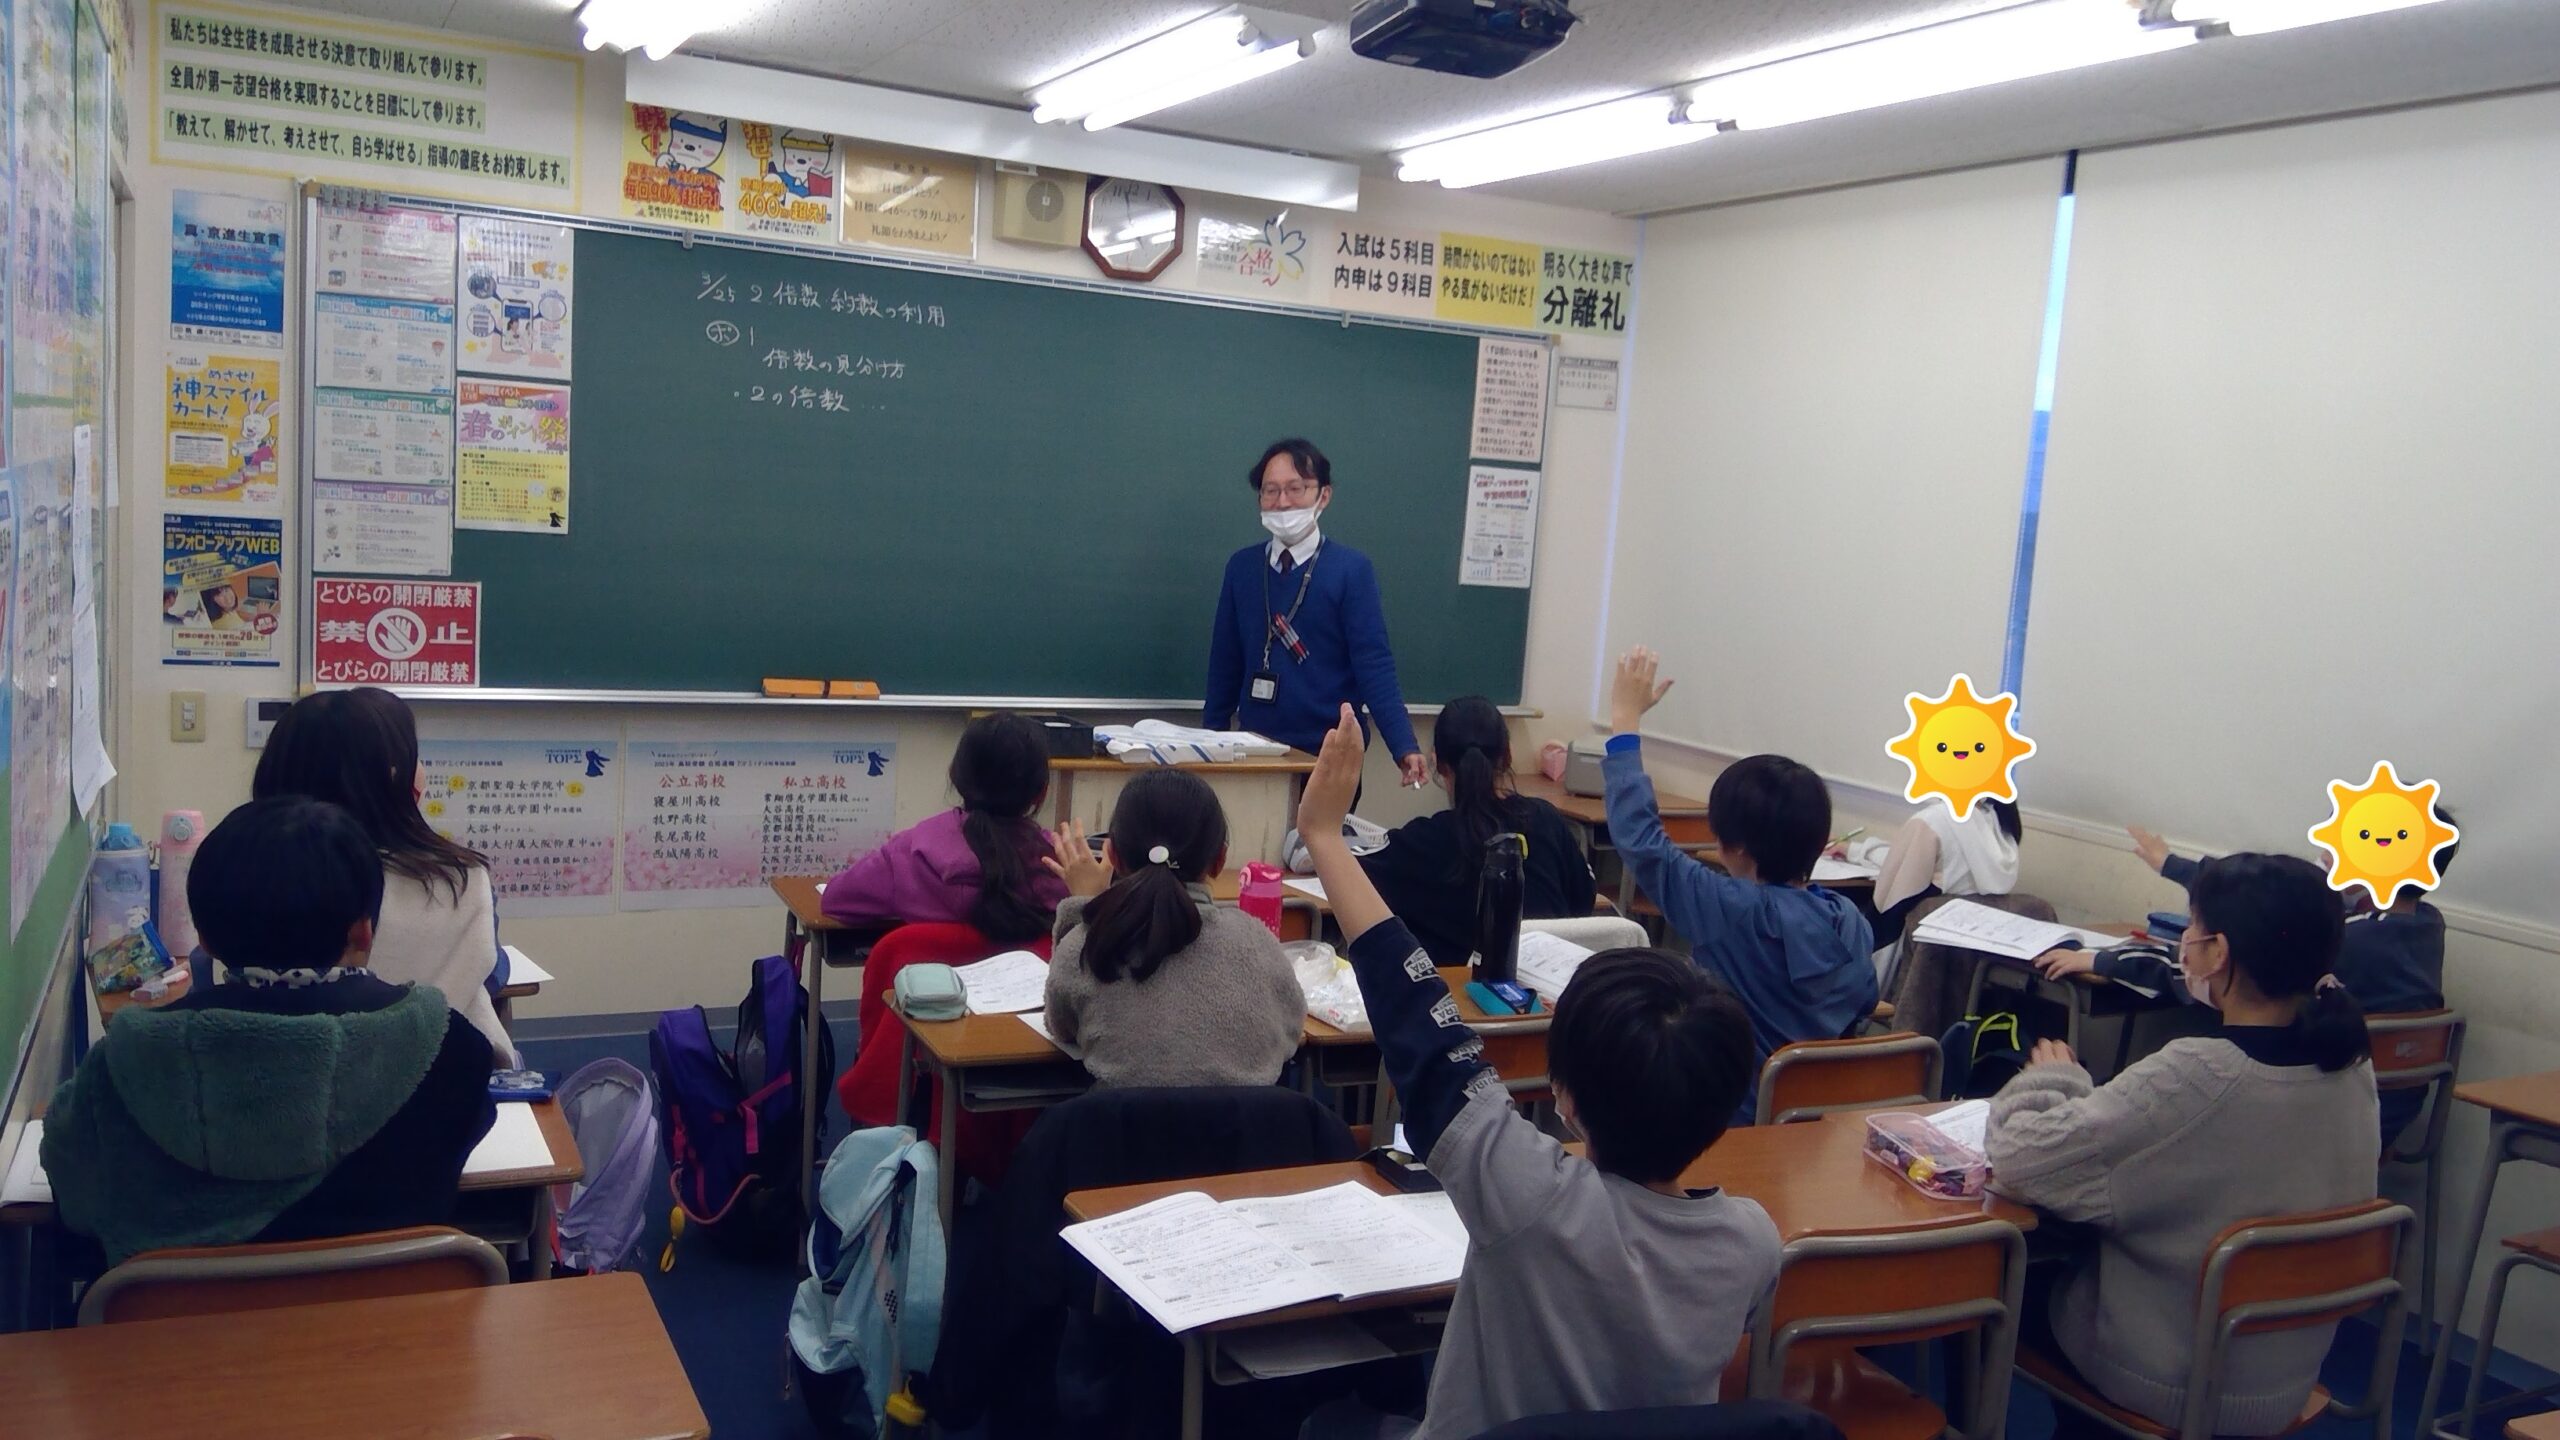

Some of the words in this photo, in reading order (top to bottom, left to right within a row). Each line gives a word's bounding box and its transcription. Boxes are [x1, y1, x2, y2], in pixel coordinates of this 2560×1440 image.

[170, 17, 483, 86] 私たちは全生徒を成長させる決意で取り組んで参ります。
[169, 66, 482, 129] 全員が第一志望合格を実現することを目標にして参ります。
[1337, 232, 1435, 267] 入試は5科目
[1334, 265, 1433, 298] 内申は9科目
[1543, 286, 1625, 331] 分離礼
[763, 347, 906, 379] 倍数の見分け方
[319, 582, 473, 608] とびらの開閉厳禁
[319, 619, 366, 643] 禁
[429, 622, 473, 645] 止
[317, 659, 470, 683] とびらの開閉厳禁
[467, 780, 565, 791] 京都聖母女学院中
[660, 774, 727, 788] 公立高校
[783, 775, 847, 789] 私立高校
[653, 795, 721, 807] 寝屋川高校
[763, 804, 805, 814] 大谷高校
[653, 813, 708, 825] 牧野高校
[763, 814, 826, 823] 大阪国際高校
[466, 823, 502, 835] 大谷中
[653, 831, 707, 843] 長尾高校
